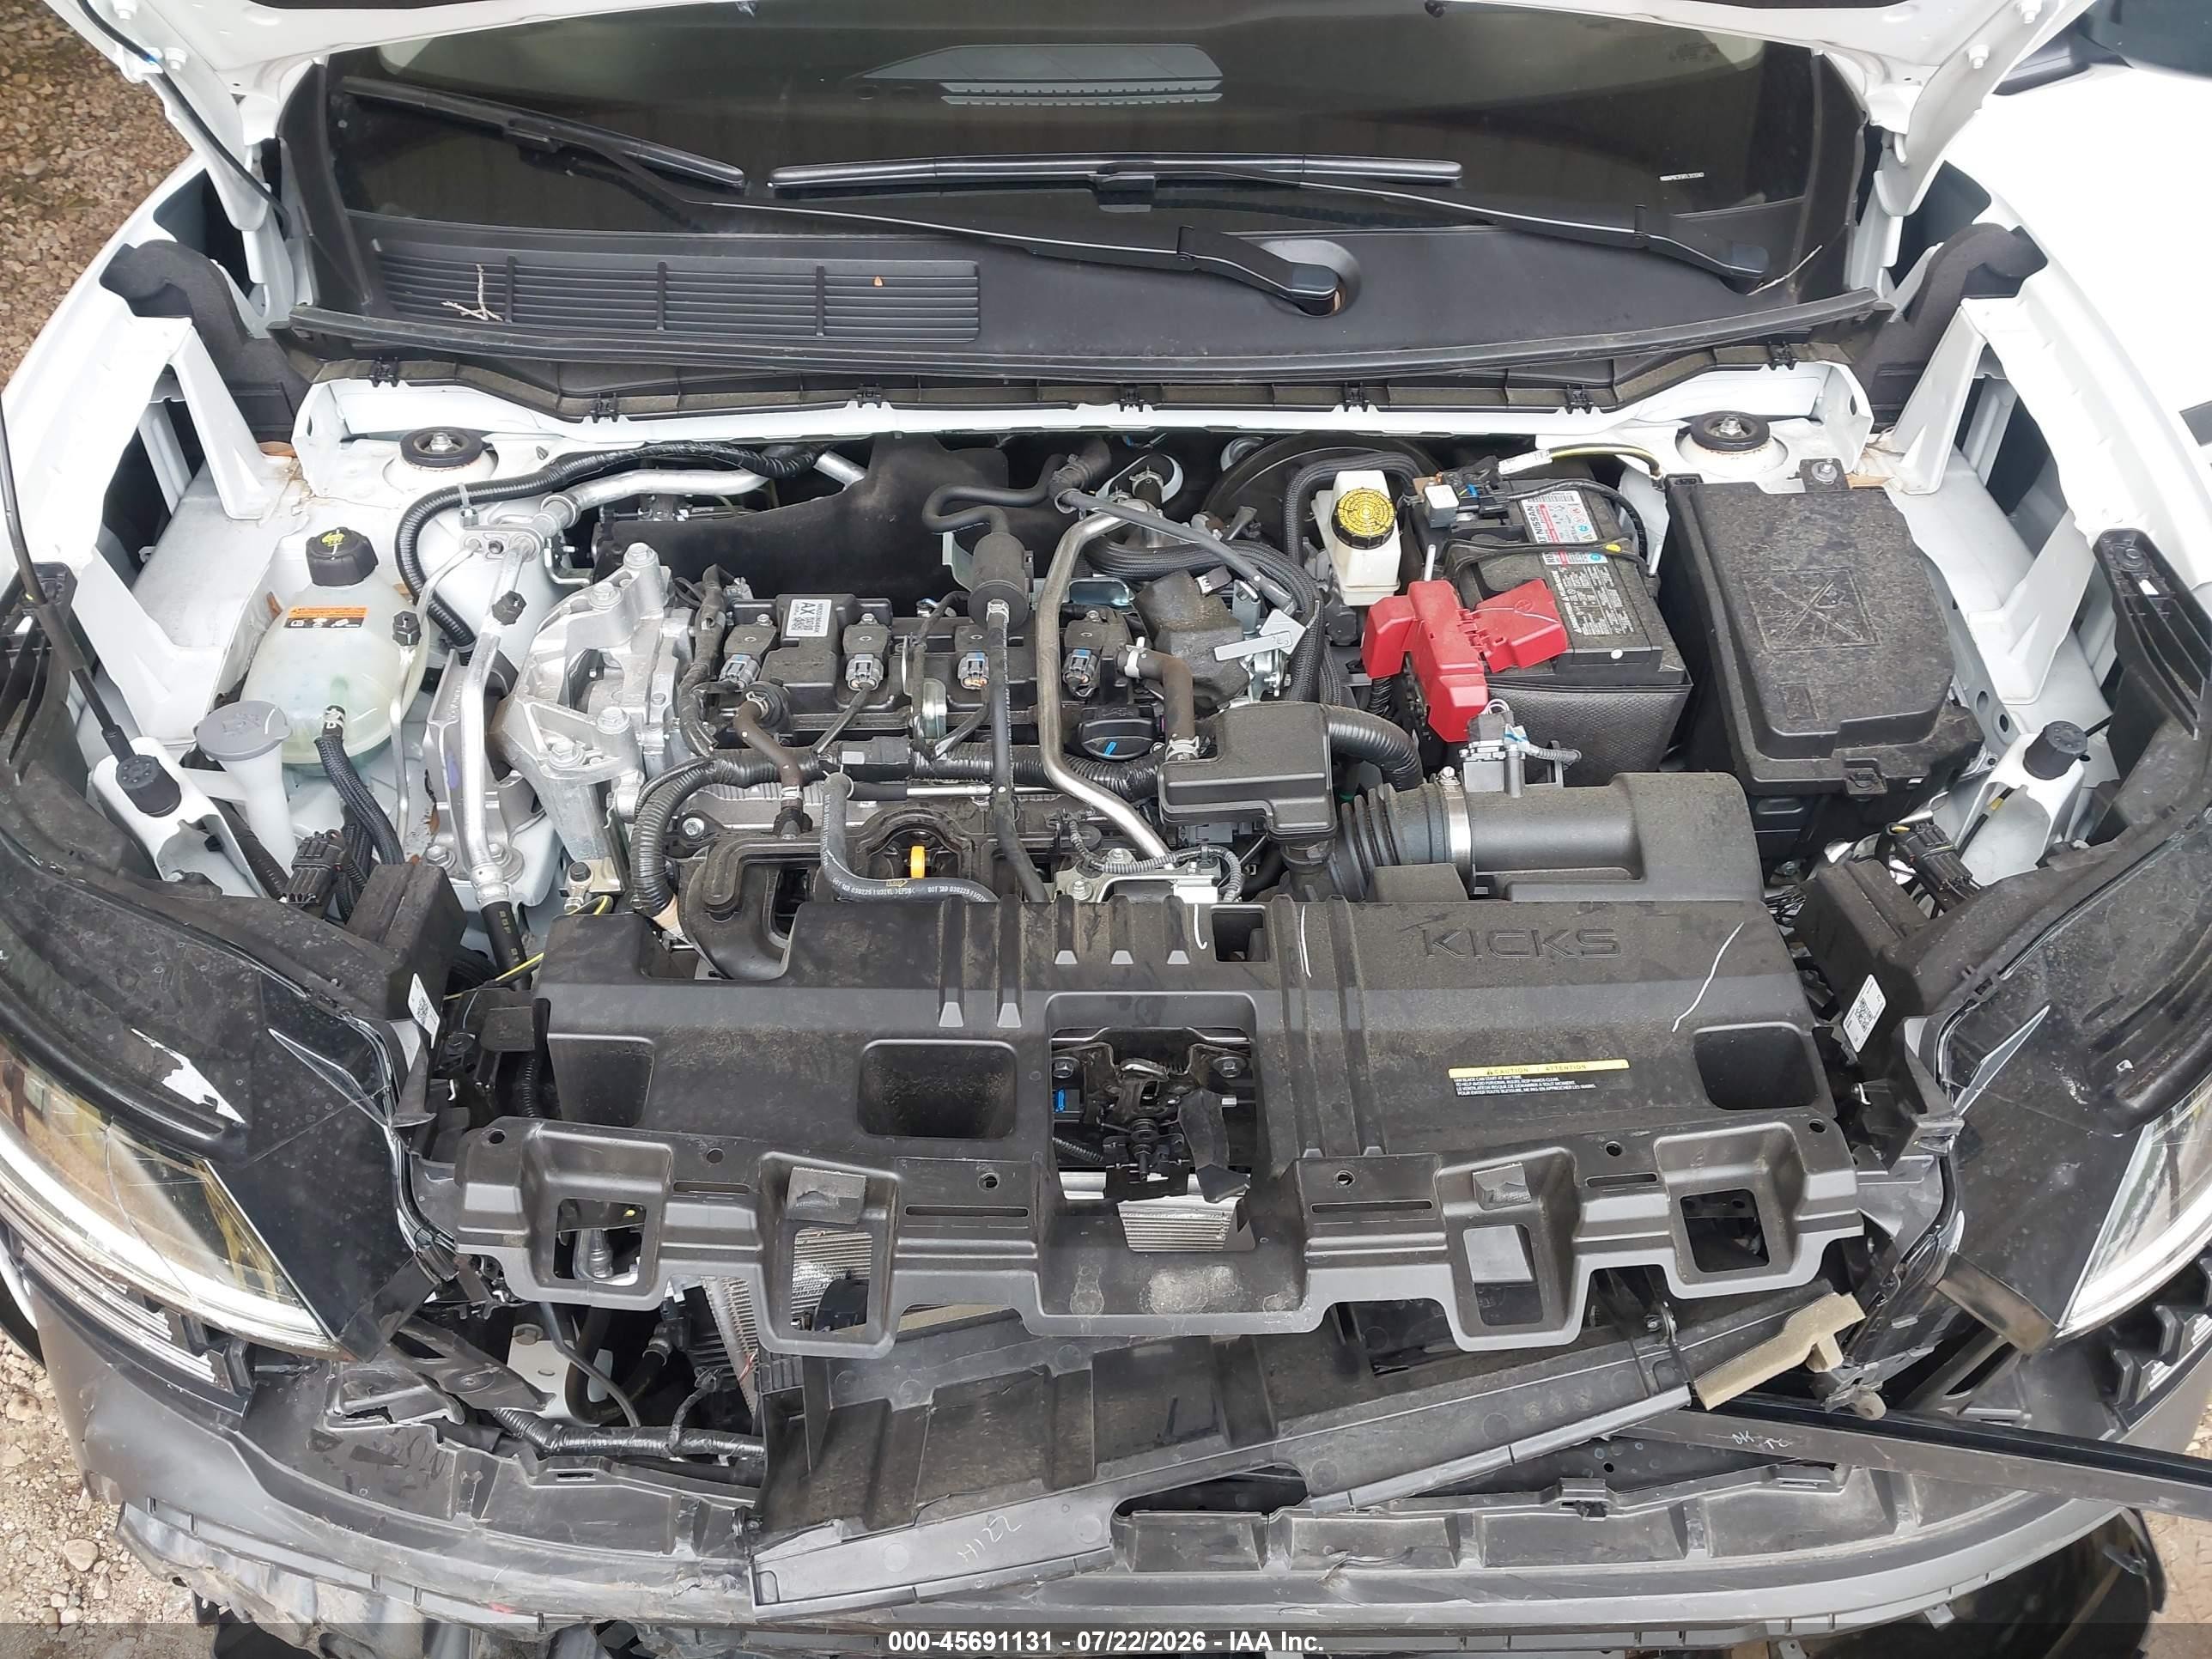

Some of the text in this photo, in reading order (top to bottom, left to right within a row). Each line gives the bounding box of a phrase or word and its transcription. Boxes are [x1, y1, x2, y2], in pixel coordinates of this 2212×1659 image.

[1525, 505, 1543, 535] NISSAN
[799, 602, 817, 615] AX
[1422, 928, 1623, 958] KICKS
